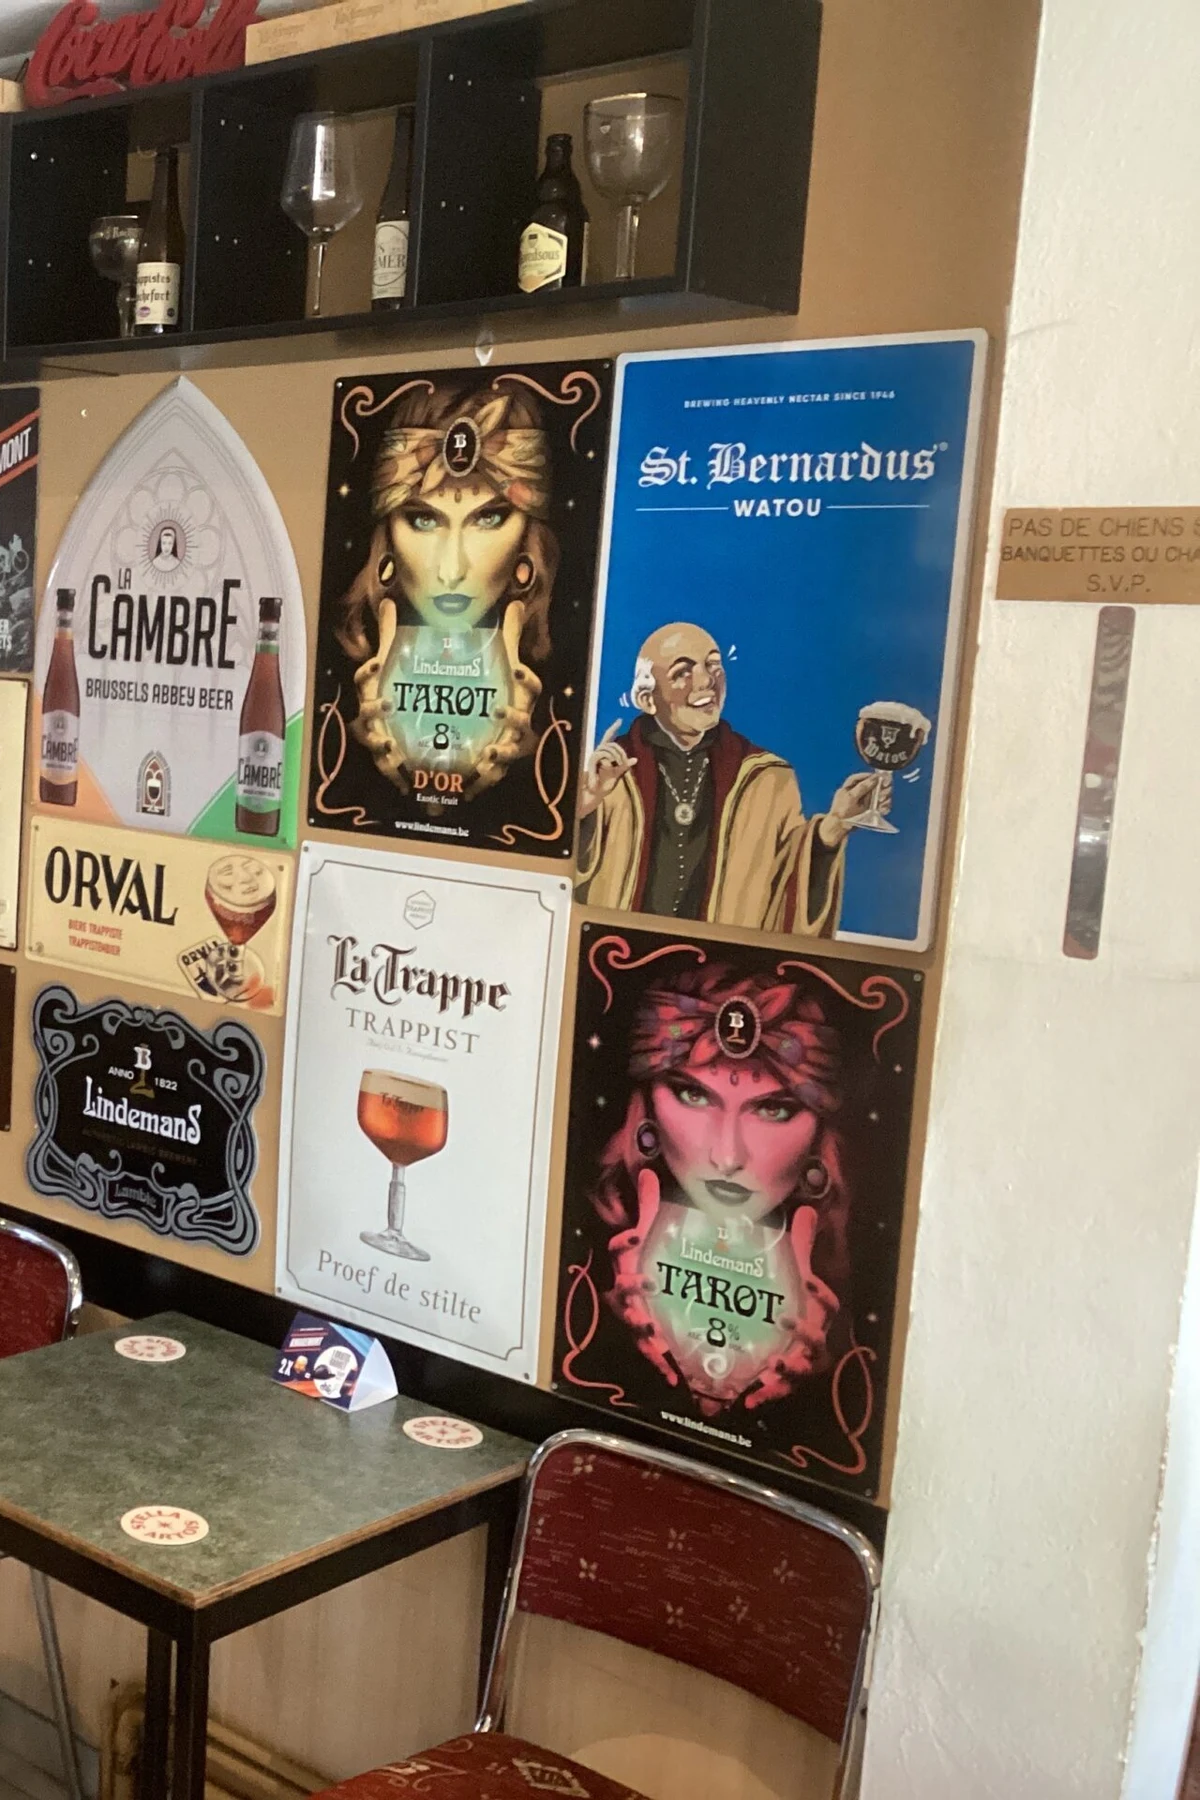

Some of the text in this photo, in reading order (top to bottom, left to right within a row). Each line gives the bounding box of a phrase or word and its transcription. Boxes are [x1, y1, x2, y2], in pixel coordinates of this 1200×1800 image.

[684, 390, 896, 408] BREWING HEAVENLY NECTAR SINCE 1946
[638, 441, 938, 490] St. Bernardus
[733, 499, 822, 517] WATOU
[1008, 518, 1052, 537] PAS
[1060, 518, 1090, 537] DE
[1098, 517, 1185, 537] CHIENS
[1001, 546, 1125, 562] BANQUETTES
[1131, 547, 1158, 562] OU
[118, 568, 132, 590] LA
[1086, 574, 1151, 593] S.V.P.
[86, 678, 233, 711] BRUSSELS ABBEY BEER
[393, 682, 497, 717] TAROT
[414, 770, 463, 793] D'OR
[416, 793, 458, 806] Exotic fruit
[395, 820, 470, 837] www.lindemans.be
[44, 846, 179, 926] ORVAL
[326, 934, 512, 1020] La Trappe
[345, 1007, 481, 1054] TRAPPIST
[108, 1066, 178, 1091] ANNO 1822
[318, 1250, 481, 1323] Proef de stilte
[657, 1261, 784, 1324] TAROT
[278, 1358, 294, 1376] 2X
[660, 1410, 753, 1448] www.lindemans.be
[130, 1510, 180, 1530] STELLA
[144, 1520, 200, 1540] ARTOIS
